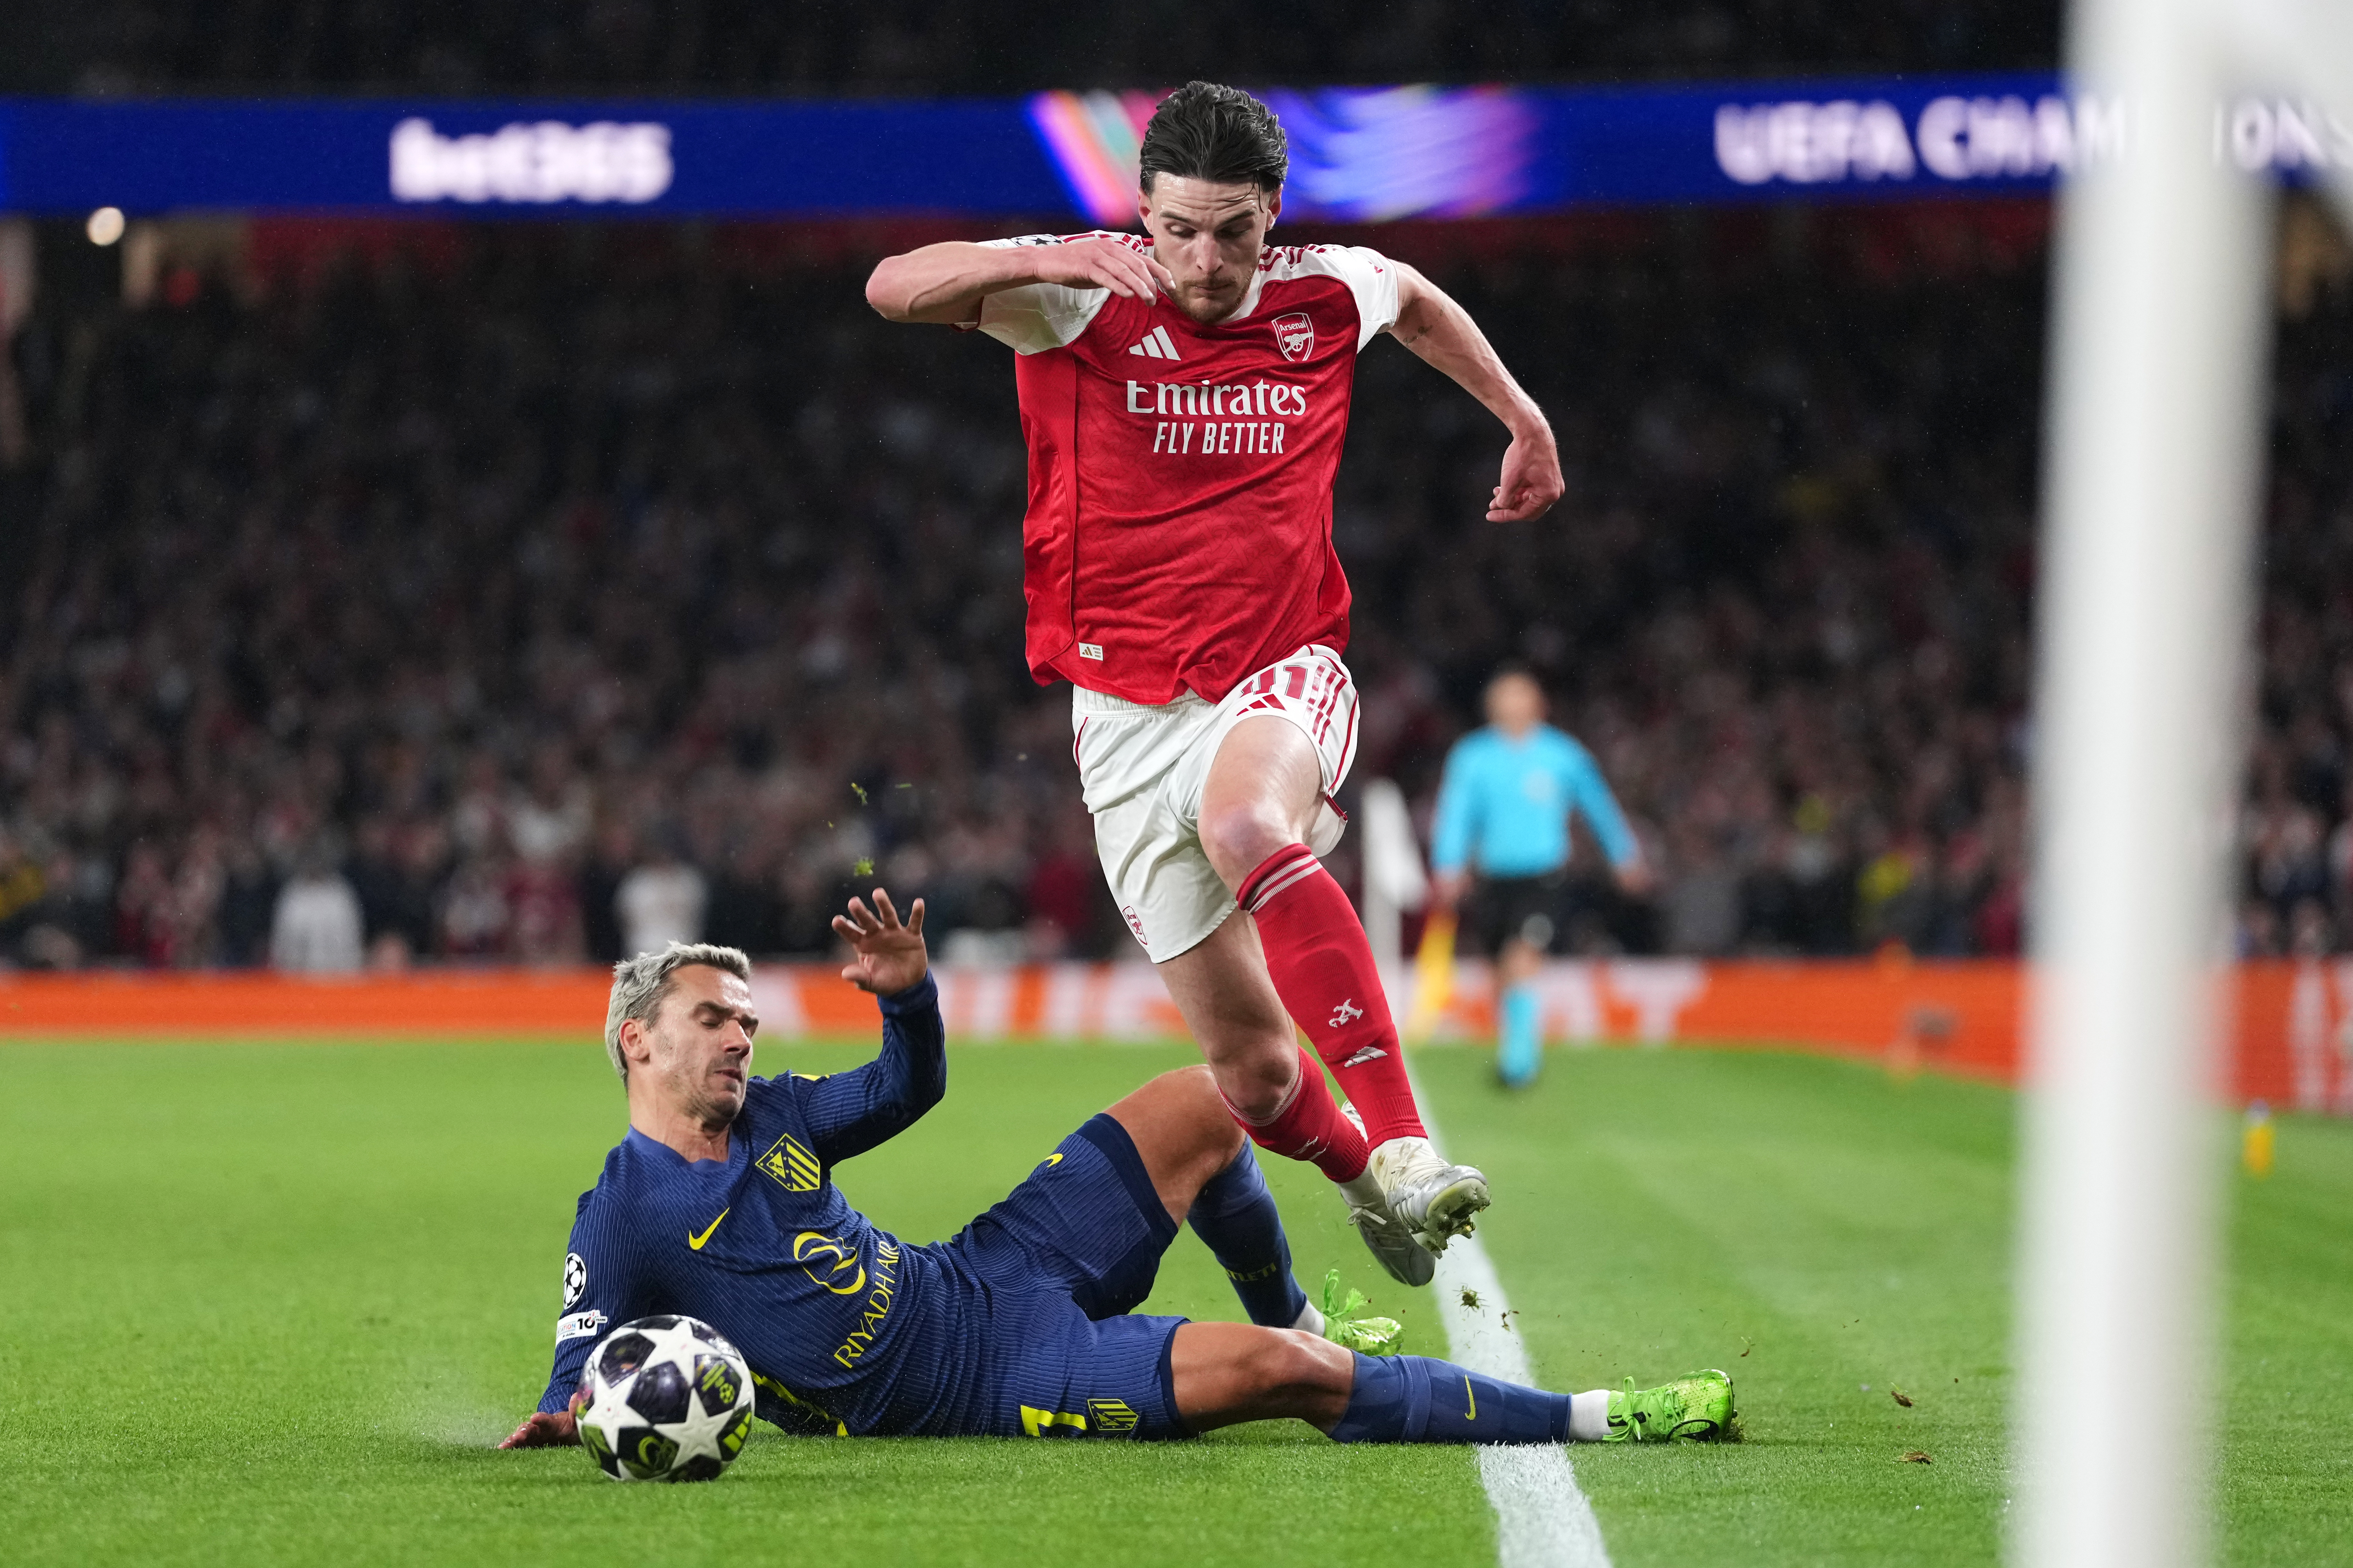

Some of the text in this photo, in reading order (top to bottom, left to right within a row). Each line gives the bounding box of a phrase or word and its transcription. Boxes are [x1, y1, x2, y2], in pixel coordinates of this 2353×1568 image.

[1714, 101, 1915, 184] UEFA
[1279, 320, 1307, 332] Arsenal
[1127, 378, 1306, 416] Emirates
[1154, 422, 1284, 455] FLY BETTER
[834, 1241, 899, 1369] RIYADH AIR
[577, 1318, 595, 1330] 10
